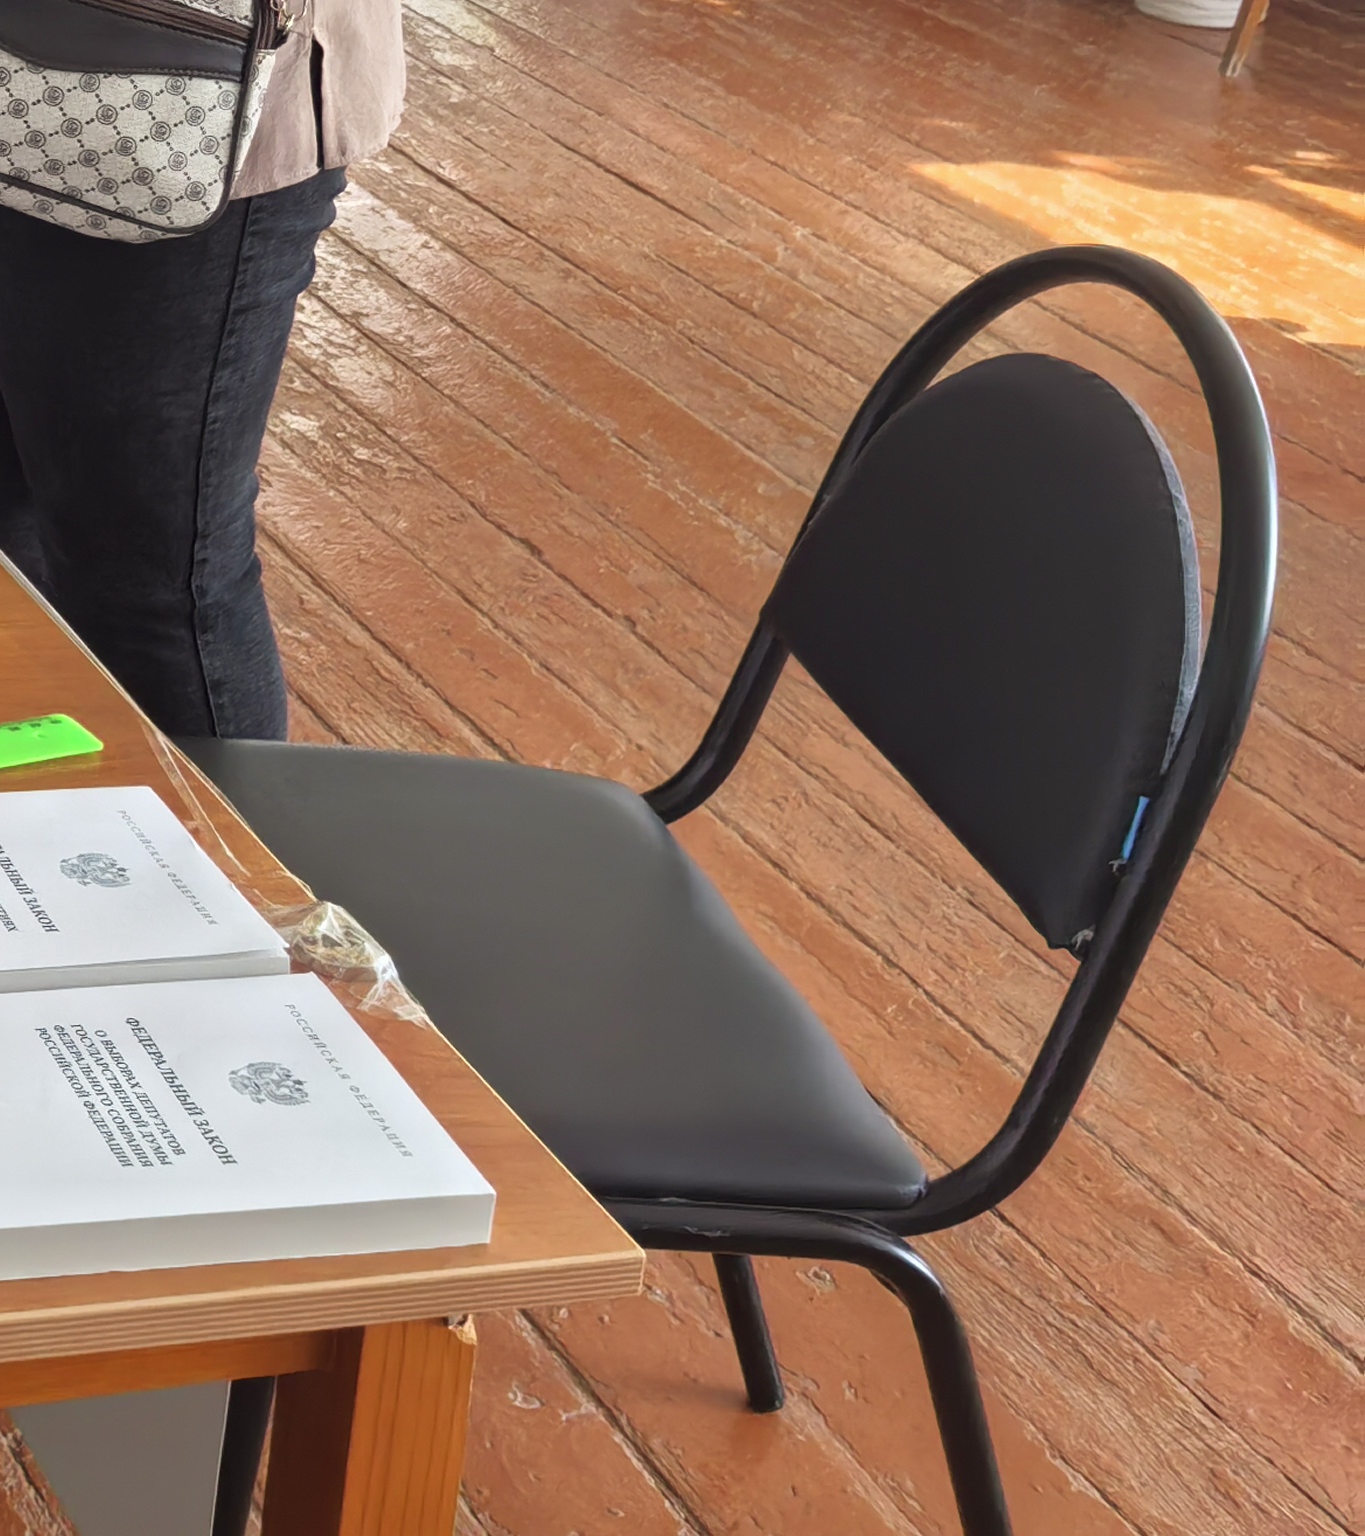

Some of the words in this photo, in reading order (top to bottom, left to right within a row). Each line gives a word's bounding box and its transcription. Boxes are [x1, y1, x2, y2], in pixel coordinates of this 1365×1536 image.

[23, 895, 60, 933] ЗАКОН
[34, 1026, 91, 1100] РОССИЙСКОЙ
[82, 1099, 135, 1169] ФЕДЕРАЦИИ
[53, 1024, 114, 1107] ФЕДЕРАЛЬНОГО
[106, 1108, 155, 1169] СОБРАНИЯ
[70, 1023, 149, 1128] ГОСУДАРСТВЕННОЙ
[137, 1128, 174, 1166] ДУМЫ
[99, 1038, 143, 1090] ВЫБОРАХ
[133, 1090, 187, 1157] ДЕПУТАТОВ
[125, 1017, 206, 1117] ФЕДЕРАЛЬНЫЙ
[192, 1118, 239, 1165] ЗАКОН
